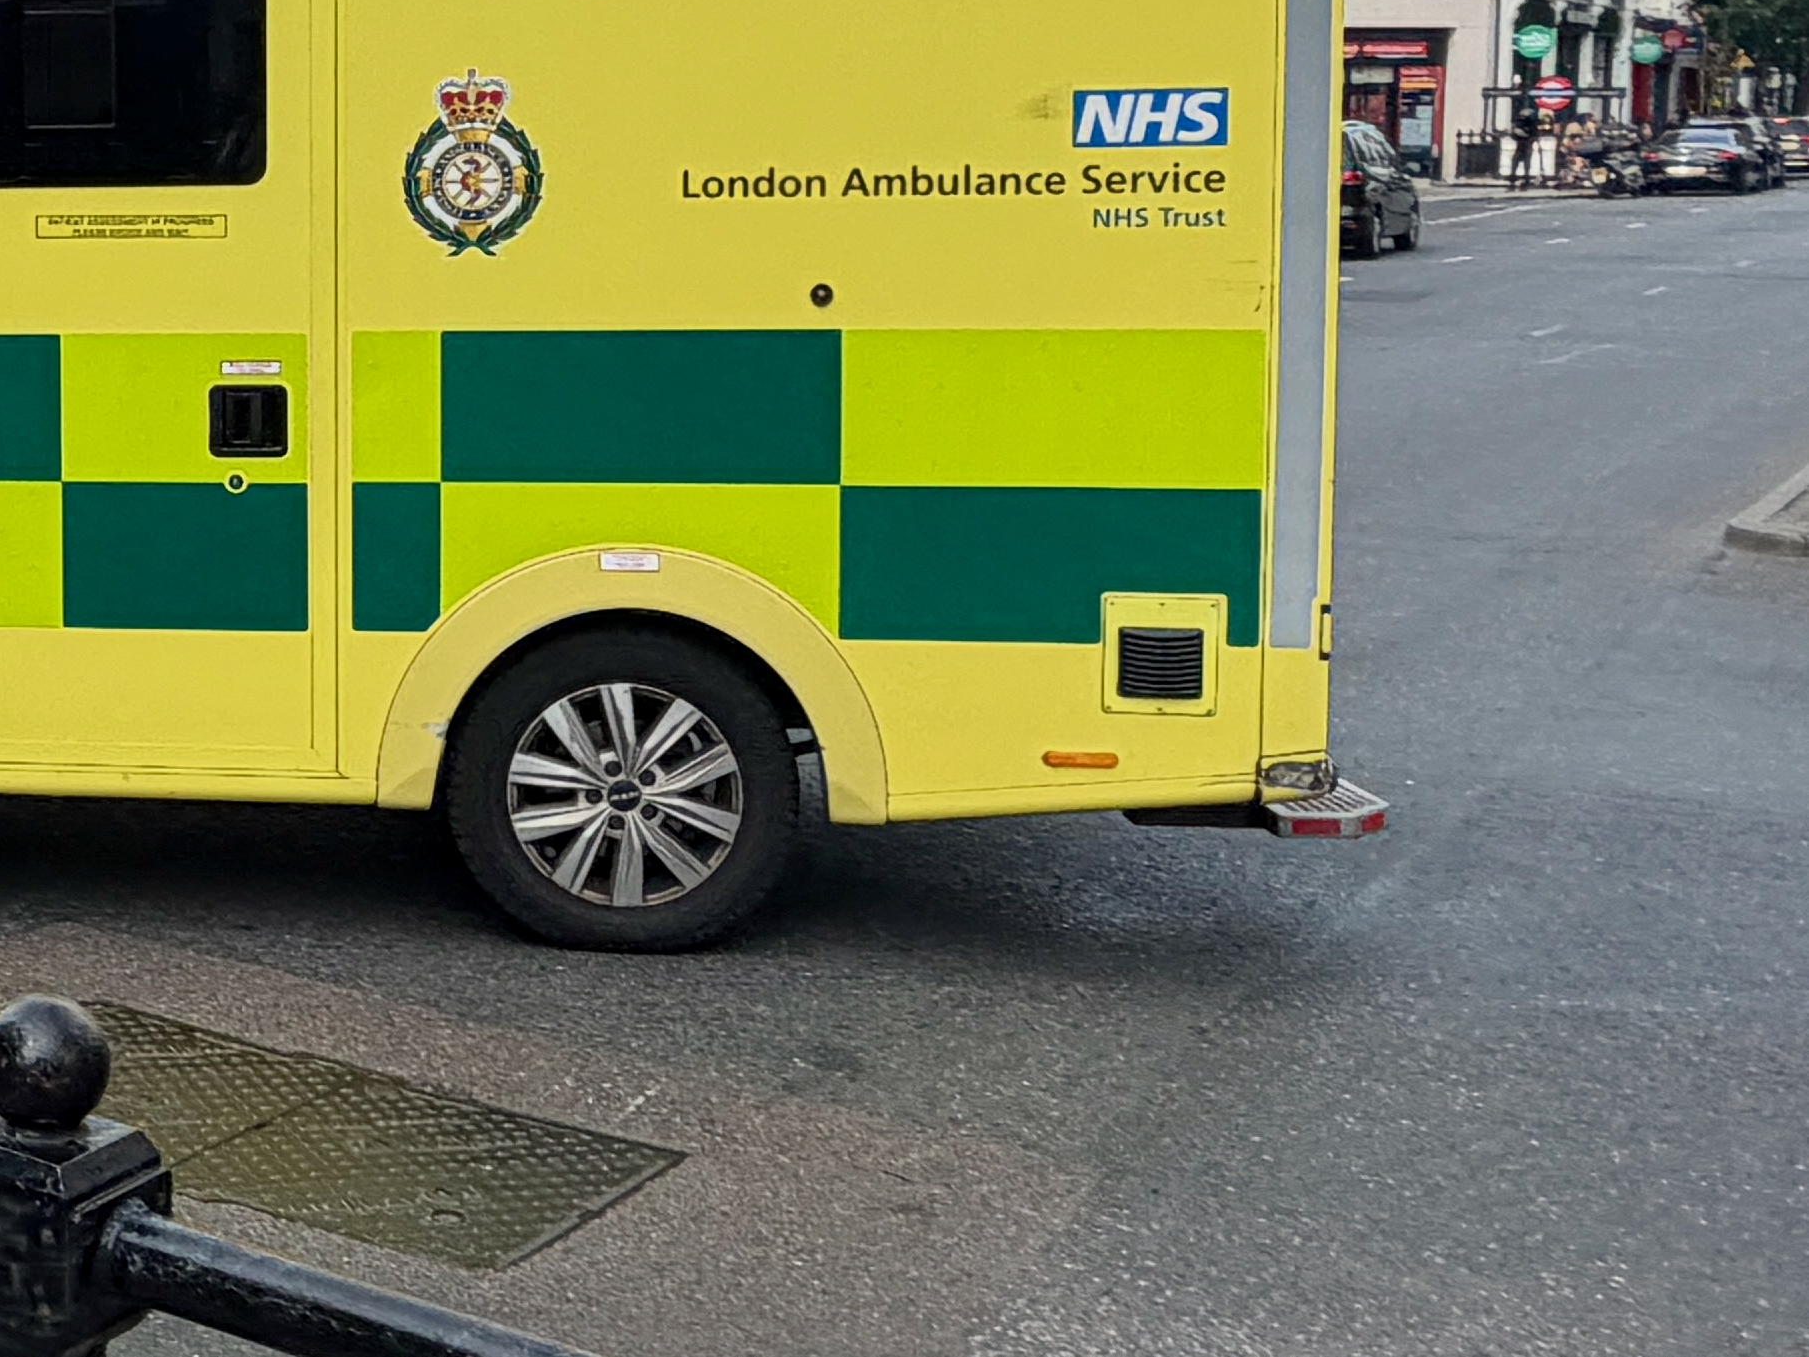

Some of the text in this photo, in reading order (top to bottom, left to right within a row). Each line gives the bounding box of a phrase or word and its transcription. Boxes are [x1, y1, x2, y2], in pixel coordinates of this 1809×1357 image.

[1075, 91, 1222, 144] NHS
[682, 162, 1226, 199] London Ambulance Service
[1093, 206, 1227, 228] NHS Trust
